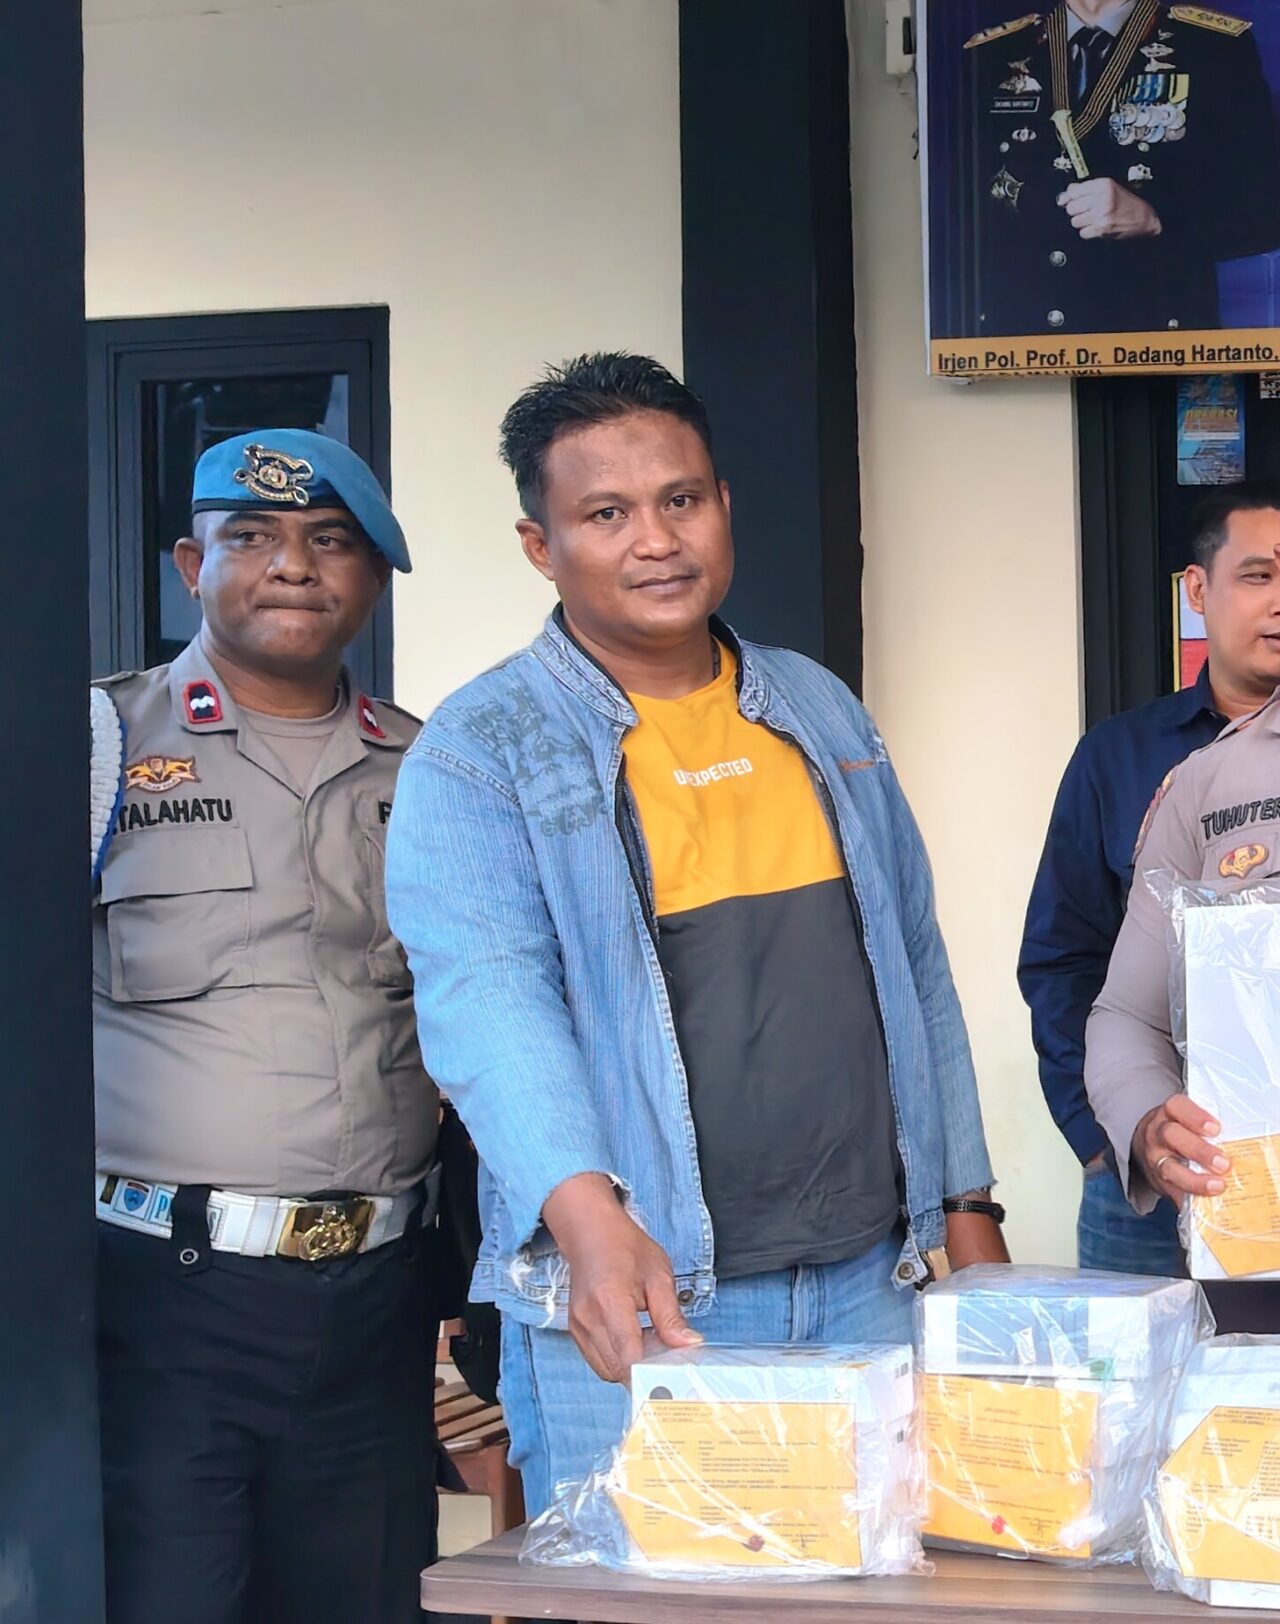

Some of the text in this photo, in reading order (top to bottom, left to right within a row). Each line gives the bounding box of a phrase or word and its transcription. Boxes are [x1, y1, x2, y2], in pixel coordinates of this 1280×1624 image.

[938, 353, 978, 373] Irjen
[985, 350, 1020, 369] Pol.
[1026, 348, 1070, 367] Prof.
[1076, 347, 1102, 366] Dr.
[1113, 346, 1186, 366] Dadang
[1191, 342, 1279, 363] Hartanto,
[673, 757, 753, 787] UEXPECTED
